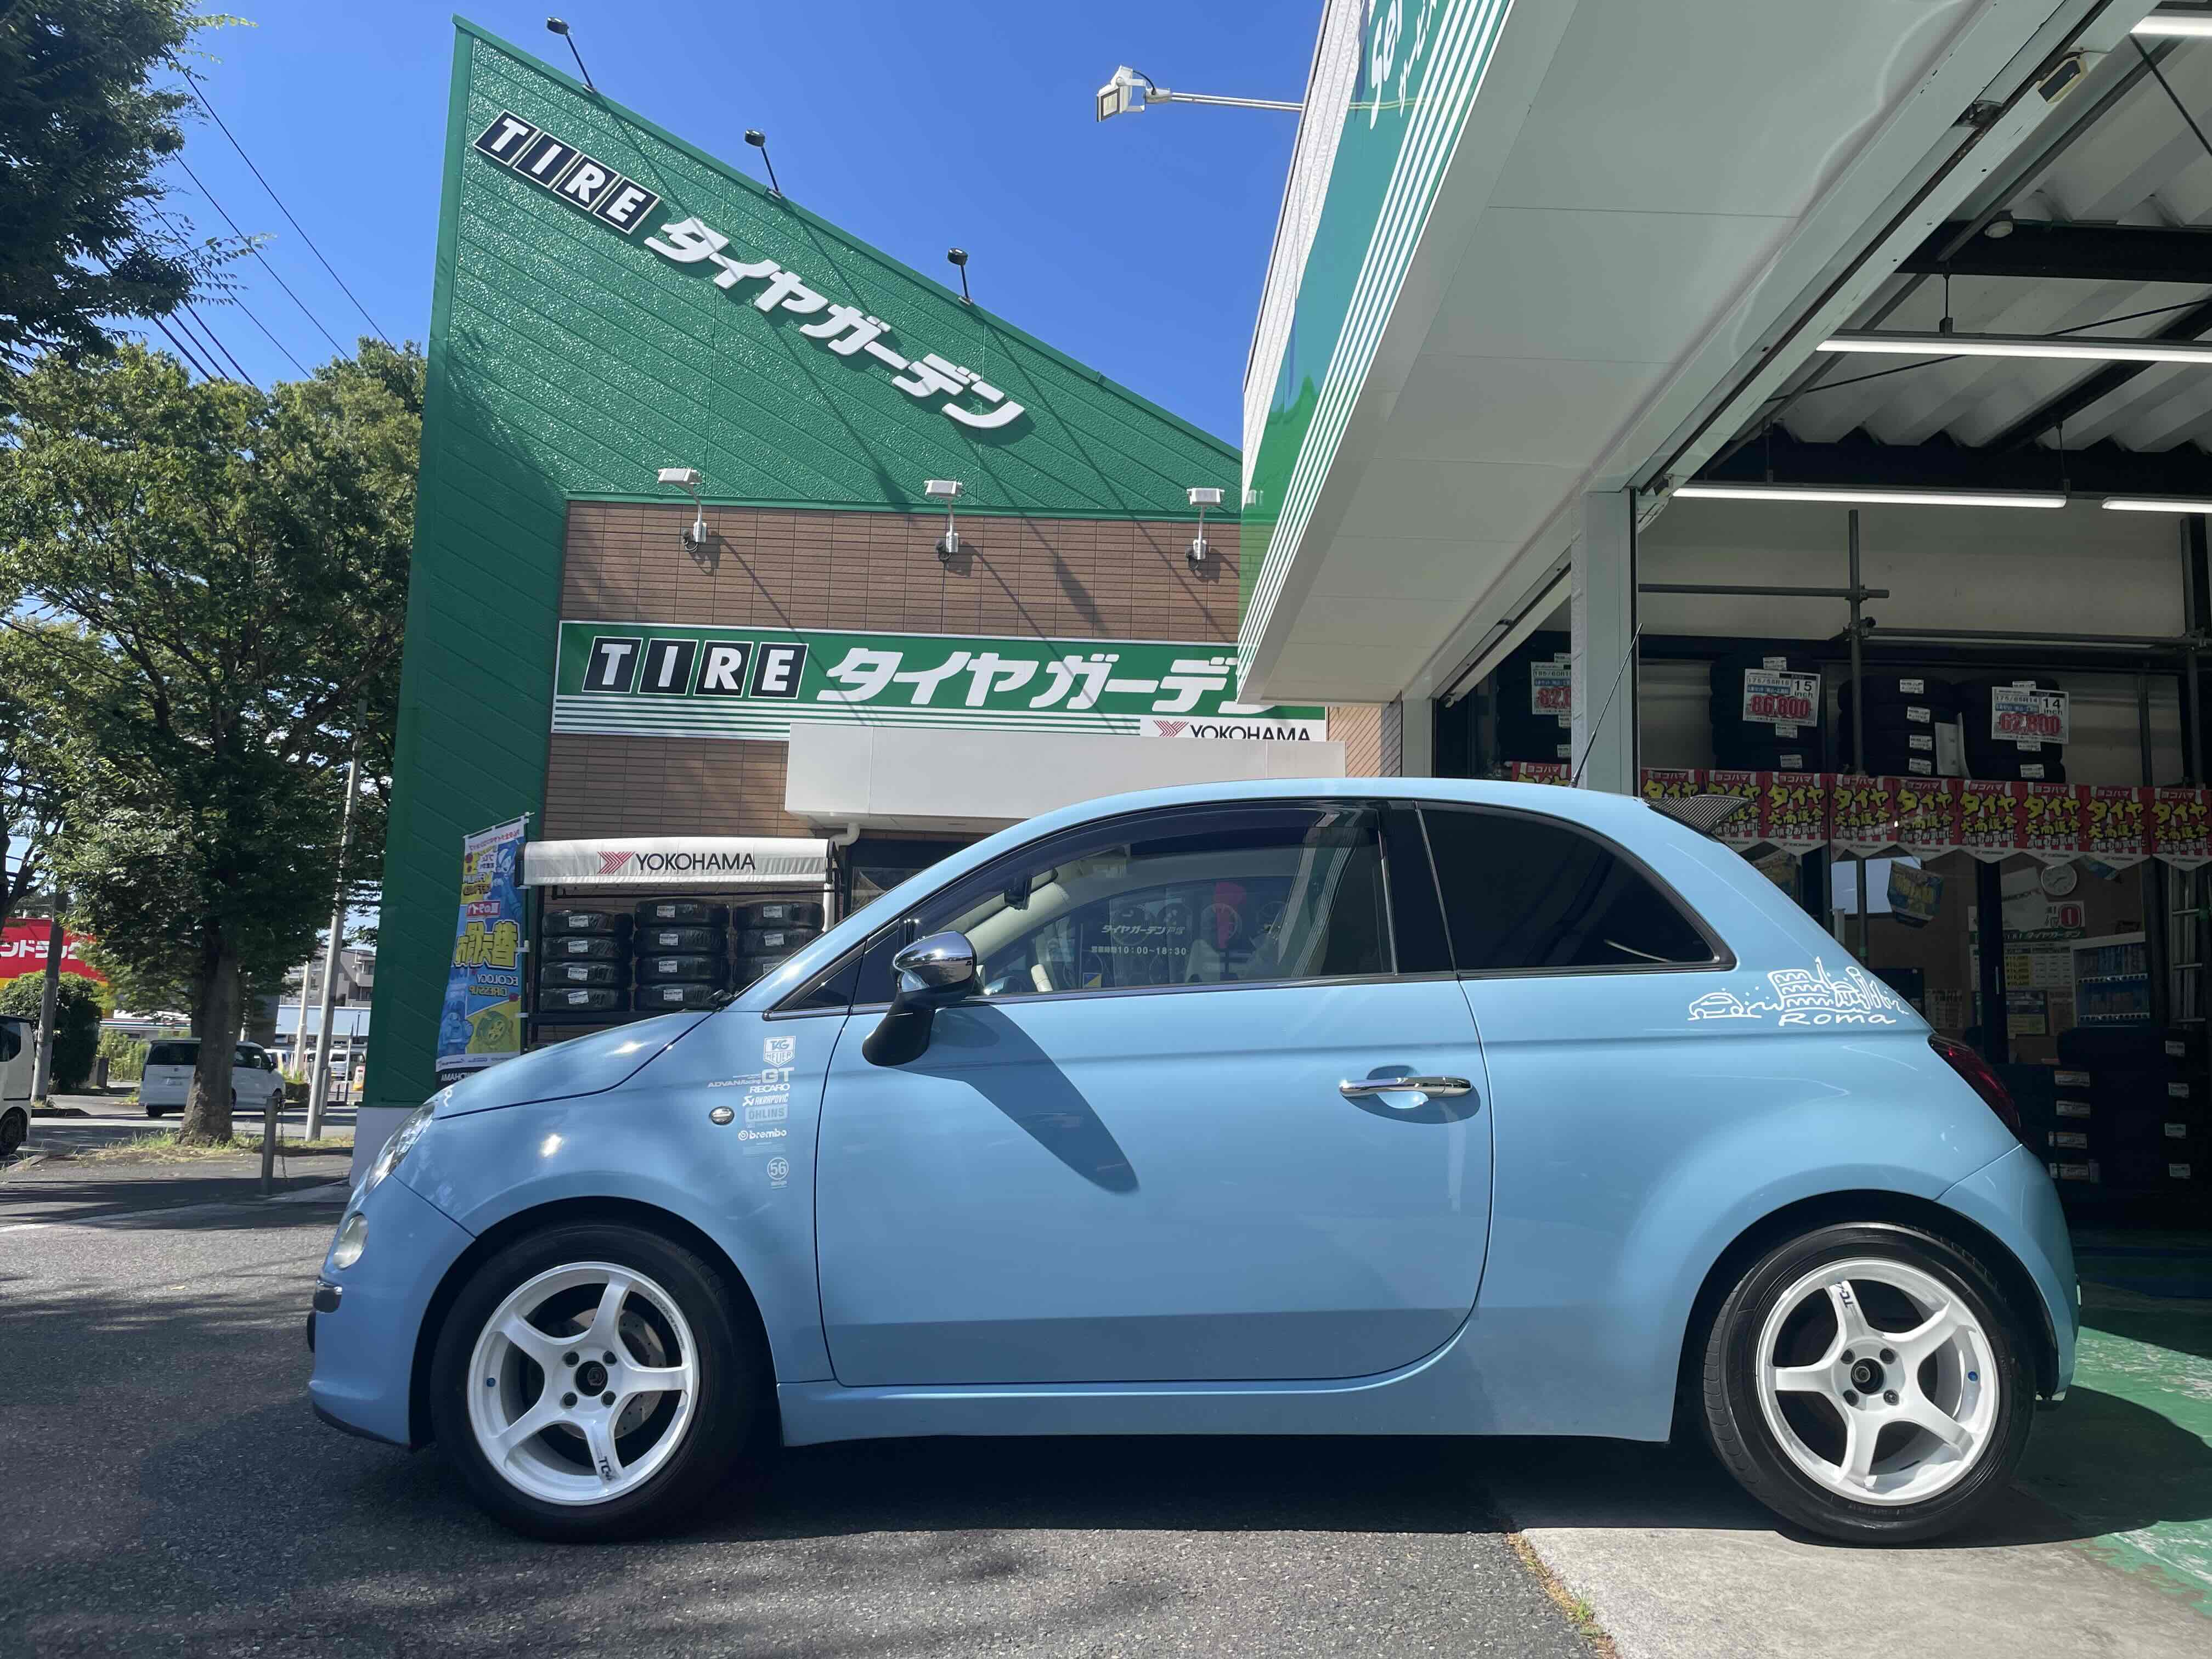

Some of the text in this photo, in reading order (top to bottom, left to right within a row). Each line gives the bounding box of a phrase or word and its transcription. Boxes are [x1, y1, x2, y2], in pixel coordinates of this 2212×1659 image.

[488, 117, 1025, 428] TIRE タイヤガーデン
[600, 643, 1277, 714] TIRE タイヤガーデ
[1795, 680, 1812, 691] 15
[2043, 699, 2059, 711] 14
[1189, 724, 1311, 741] YOKOHAMA
[1779, 775, 1812, 784] ヨコハマ
[1768, 785, 1825, 809] タイヤ
[1833, 786, 1889, 810] タイヤ
[1897, 789, 1953, 813] タイヤ
[1960, 792, 2017, 816] タイヤ
[2023, 795, 2081, 820] タイヤ
[2086, 800, 2143, 823] タイヤ
[2151, 801, 2207, 825] タイヤ
[635, 852, 756, 871] YOKOHAMA
[1778, 1013, 1897, 1026] Roma
[707, 1079, 741, 1088] ADVAN
[761, 1067, 794, 1084] GT
[749, 1083, 791, 1093] RECARO
[749, 1128, 787, 1139] brembo
[770, 1161, 787, 1176] 56
